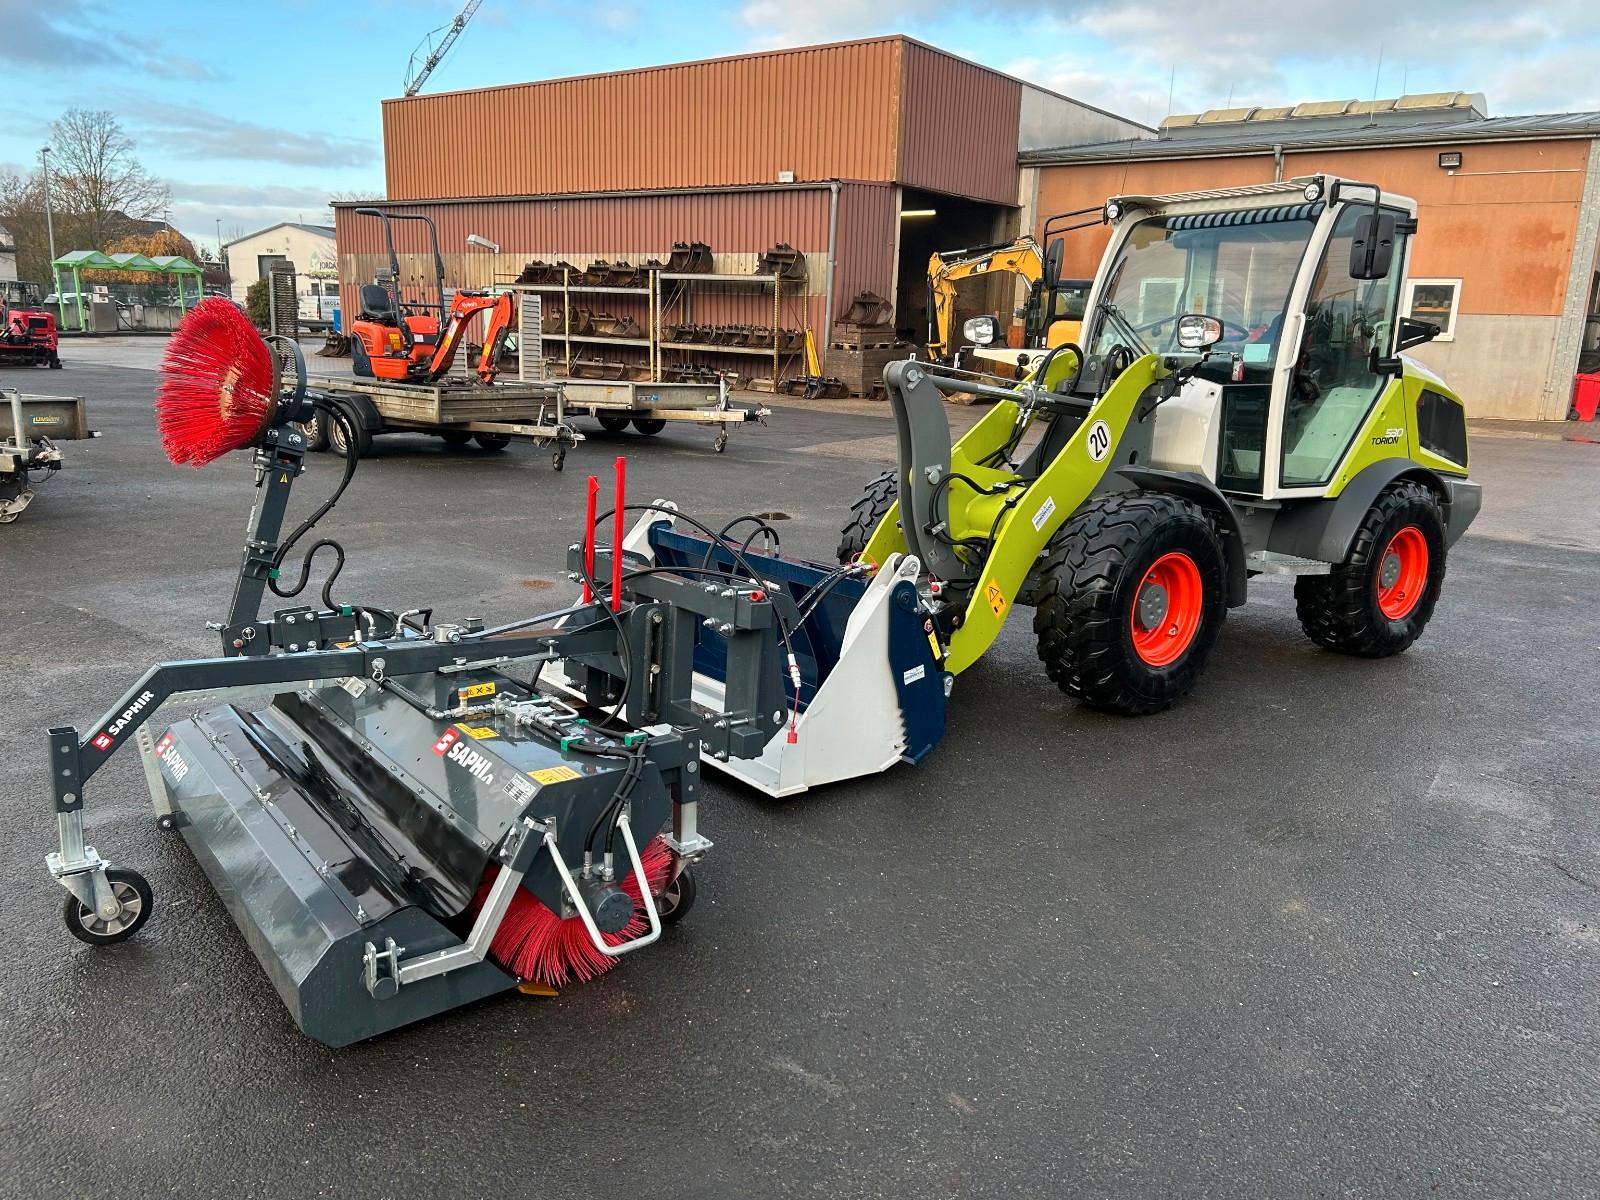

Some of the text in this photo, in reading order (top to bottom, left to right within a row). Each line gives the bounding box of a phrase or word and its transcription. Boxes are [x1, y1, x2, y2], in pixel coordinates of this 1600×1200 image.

[1090, 425, 1108, 458] 20
[1371, 436, 1400, 445] TORION
[108, 690, 155, 736] SAPHIR
[161, 745, 189, 783] SAPHIR
